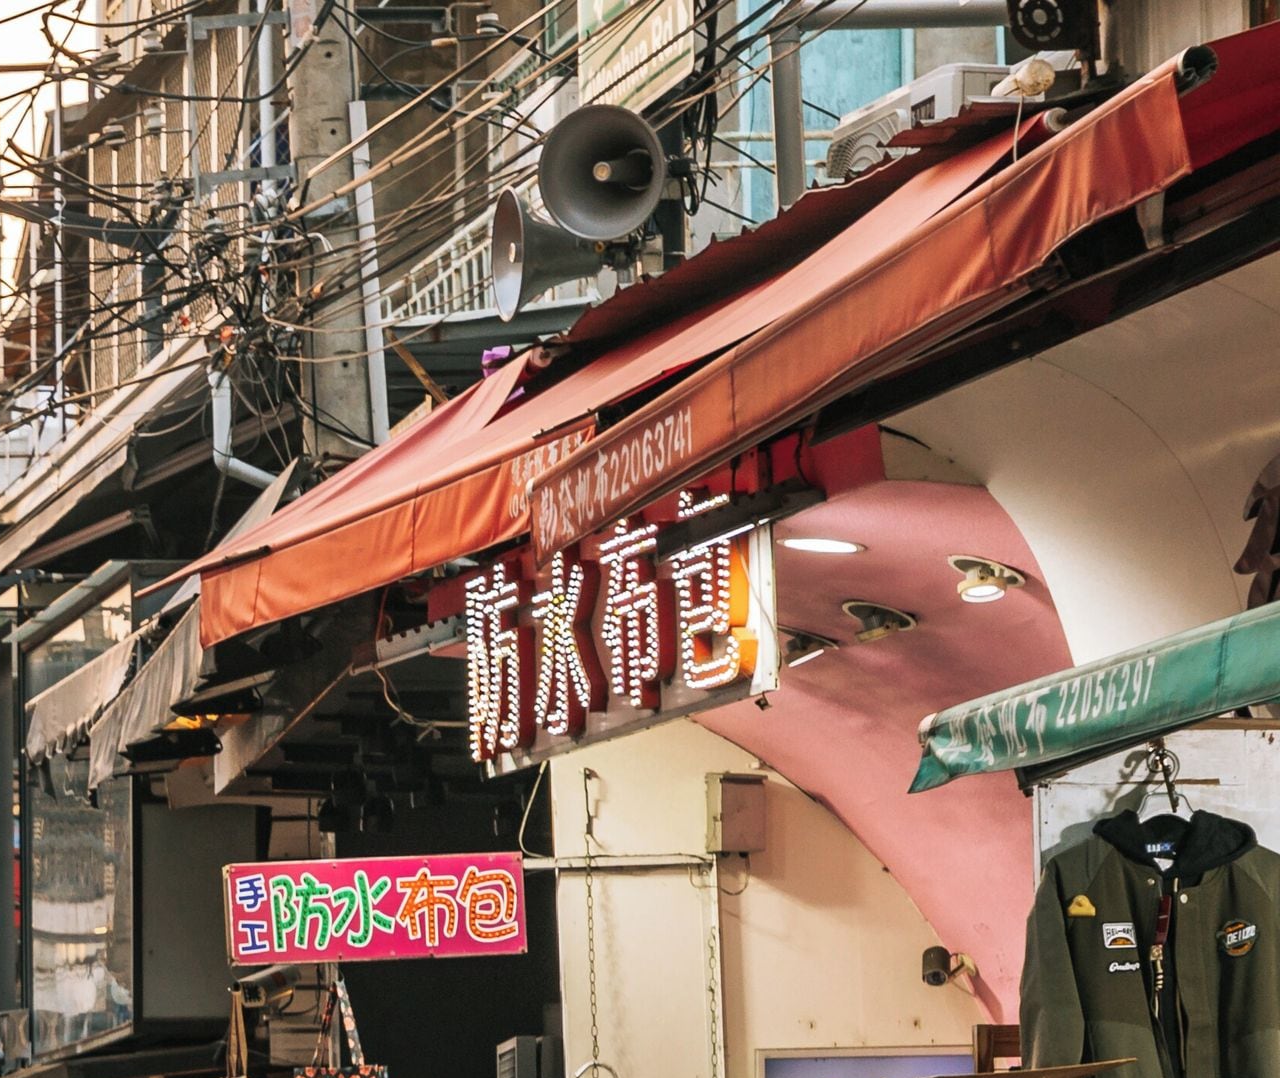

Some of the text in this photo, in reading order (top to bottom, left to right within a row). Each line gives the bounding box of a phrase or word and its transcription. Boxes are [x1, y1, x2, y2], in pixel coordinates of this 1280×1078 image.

[609, 405, 693, 501] 22063741
[464, 490, 740, 762] 防水布包
[1055, 655, 1158, 729] 22056297
[269, 866, 522, 951] 防水布包
